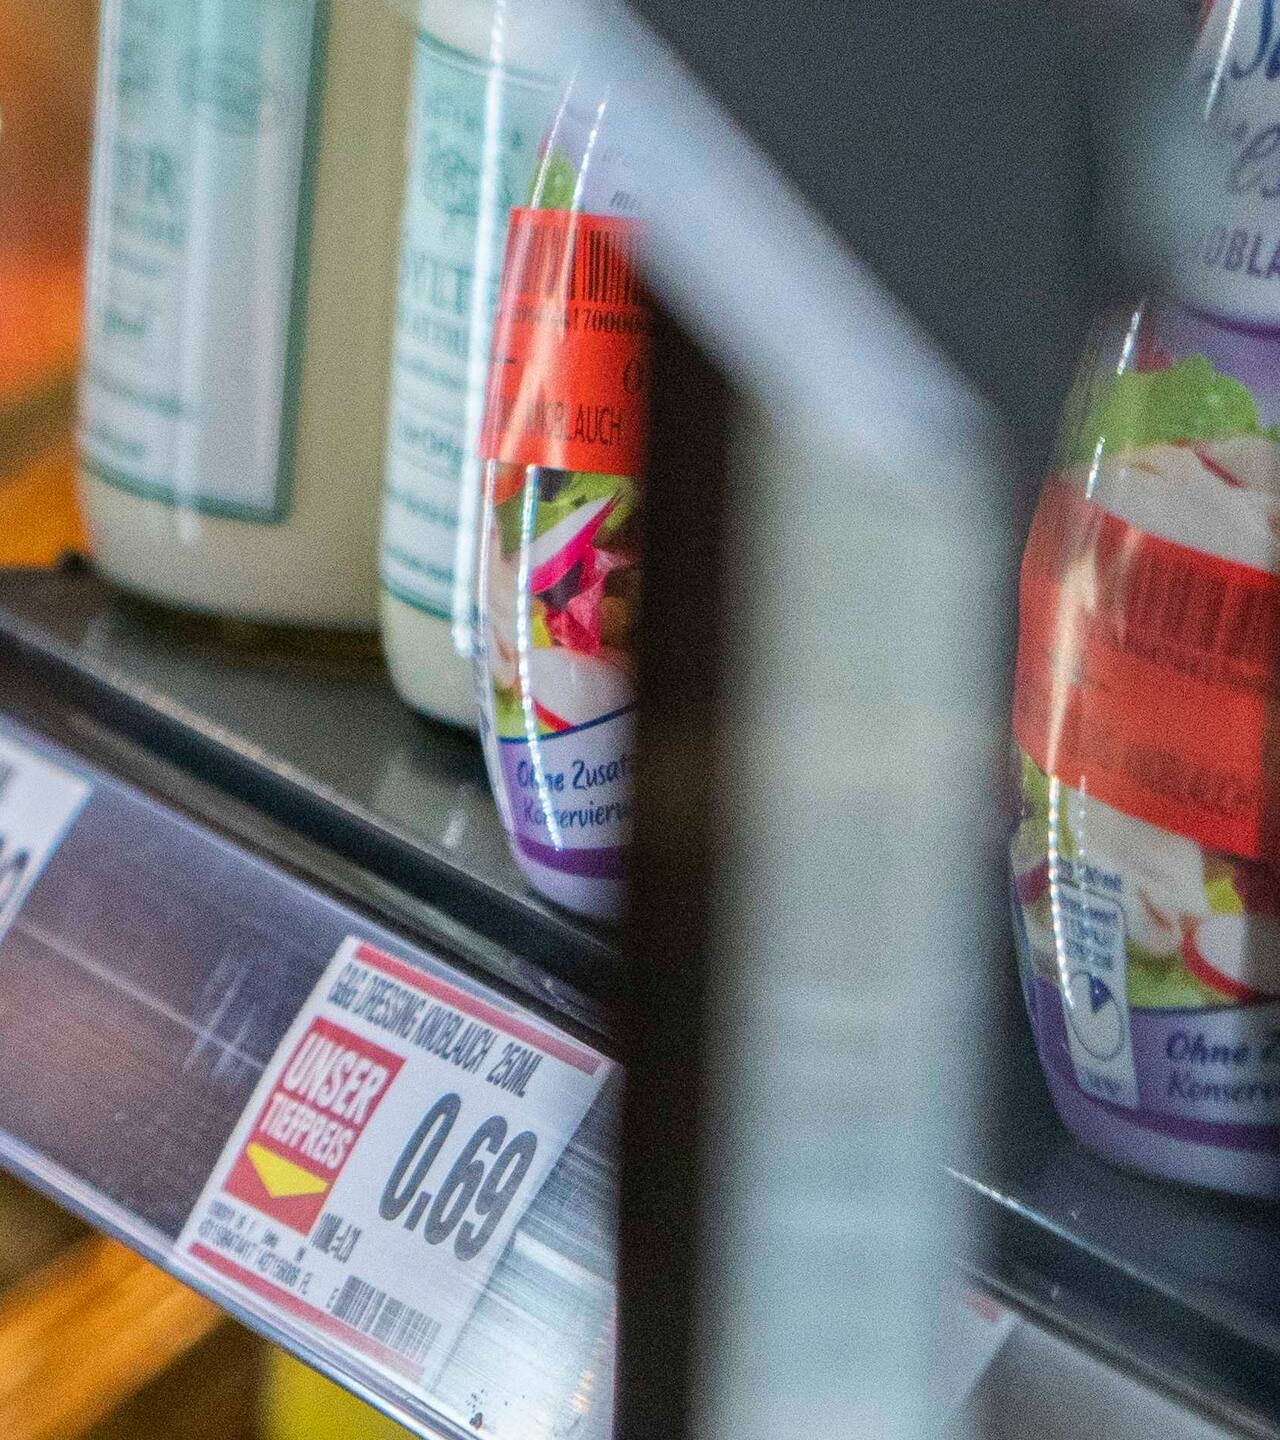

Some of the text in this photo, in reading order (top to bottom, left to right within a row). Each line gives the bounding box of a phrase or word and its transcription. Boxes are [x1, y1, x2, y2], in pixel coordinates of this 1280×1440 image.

[570, 754, 630, 791] Zusat
[281, 1032, 391, 1125] UNSER
[351, 974, 428, 1040] DRESSING
[408, 1001, 501, 1076] KNOBLAUCH
[485, 1041, 544, 1099] 250ML
[258, 1091, 357, 1172] TIEFPREIS
[377, 1092, 539, 1263] 0.69
